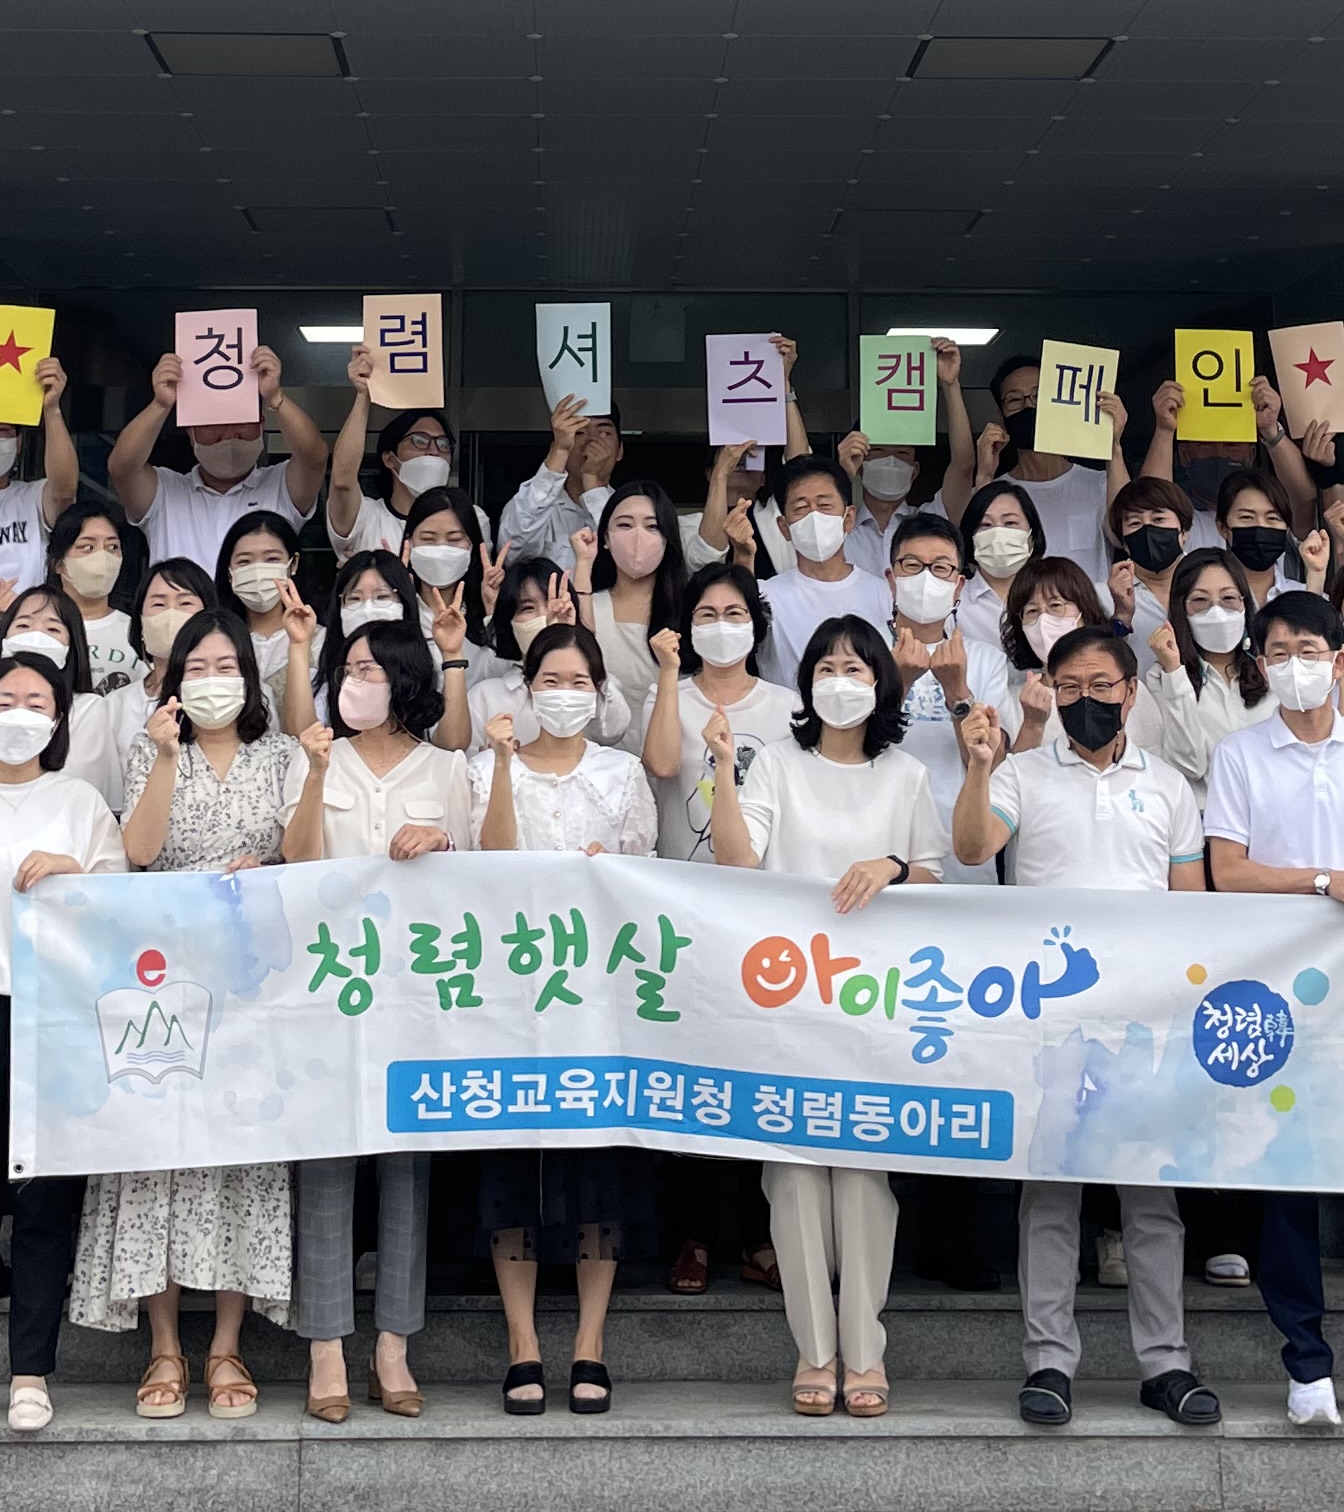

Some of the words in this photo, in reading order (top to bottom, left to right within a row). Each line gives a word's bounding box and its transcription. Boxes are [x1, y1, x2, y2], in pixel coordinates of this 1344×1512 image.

[193, 324, 246, 390] 청
[378, 311, 429, 374] 렴
[547, 322, 599, 383] 셔
[721, 350, 778, 405] 츠
[873, 351, 925, 412] 캠
[1051, 362, 1106, 426] 페
[1191, 347, 1244, 409] 인
[88, 645, 139, 671] RDI
[307, 908, 692, 1022] 청렴햇살
[742, 933, 1100, 1065] 아이좋아
[1206, 1037, 1275, 1079] 세상
[409, 1068, 735, 1128] 산청교육지원청
[751, 1085, 993, 1150] 청렴동아리
